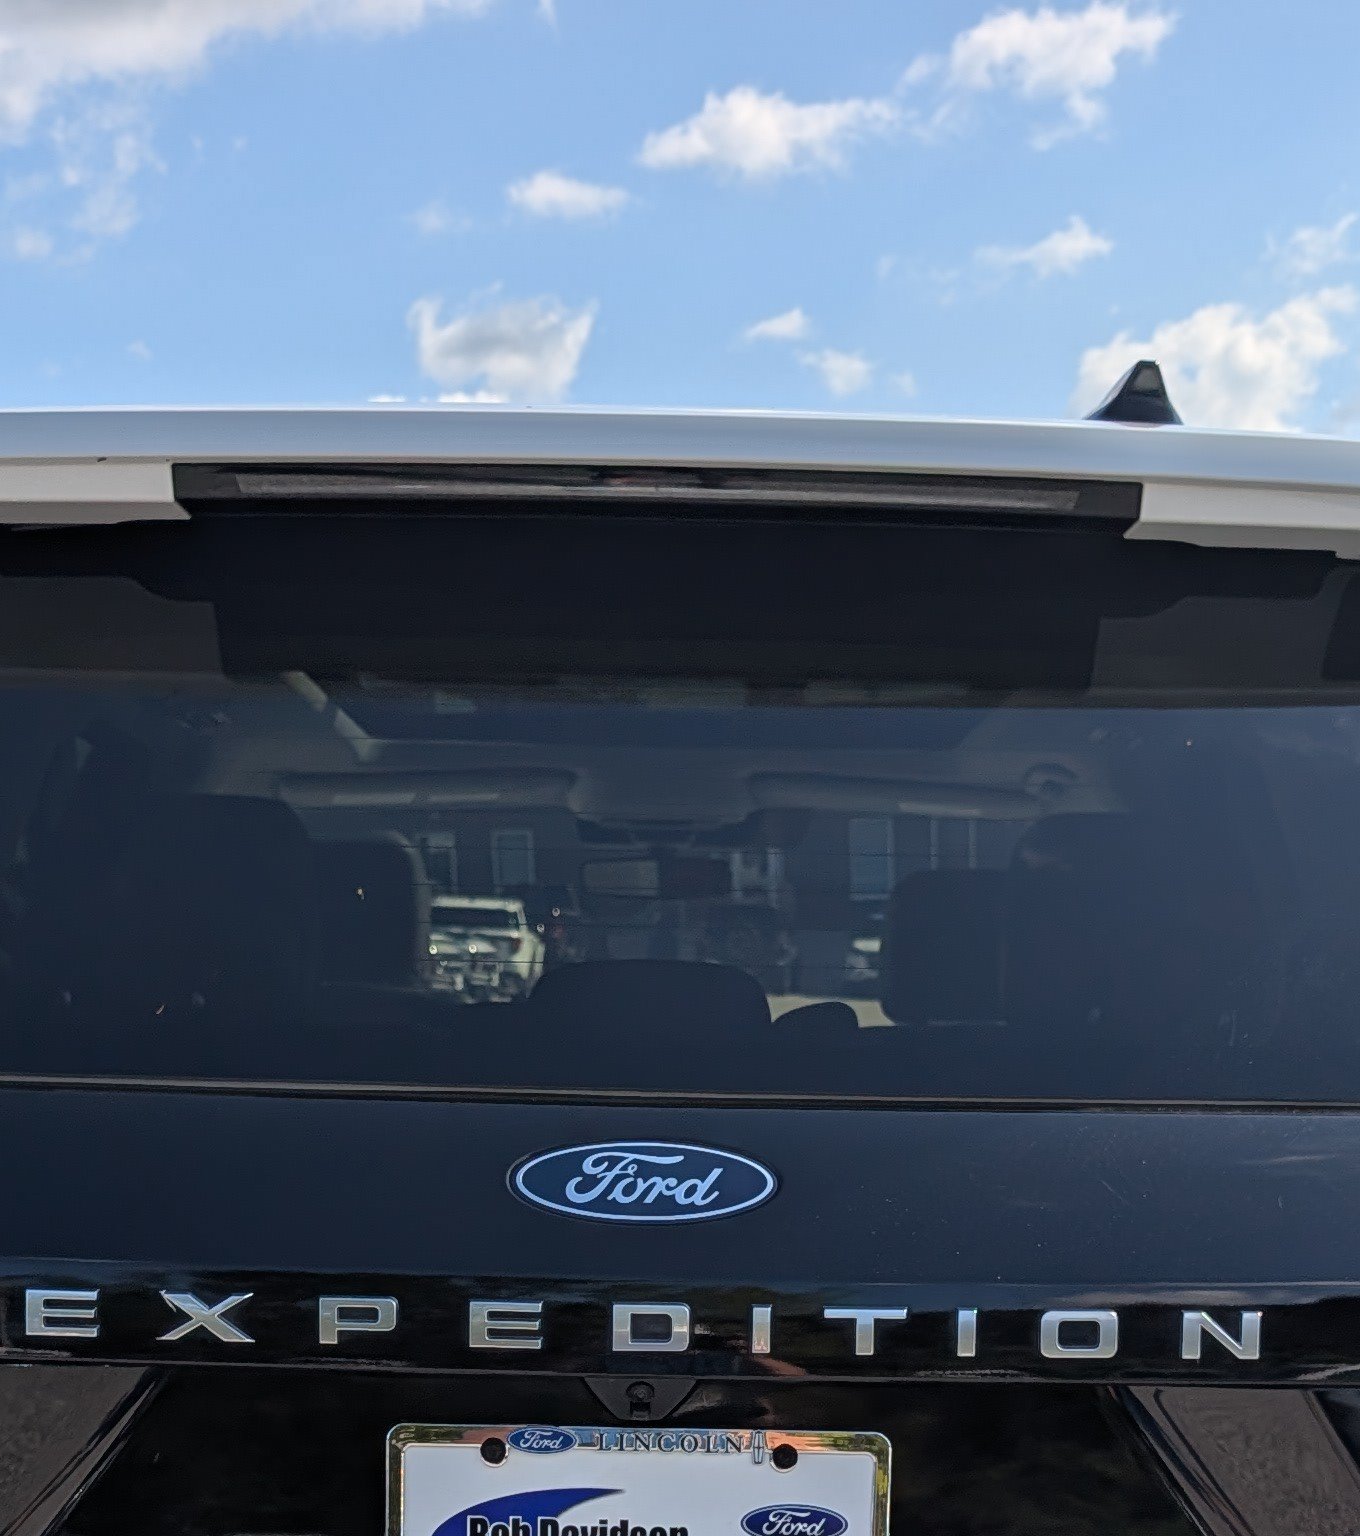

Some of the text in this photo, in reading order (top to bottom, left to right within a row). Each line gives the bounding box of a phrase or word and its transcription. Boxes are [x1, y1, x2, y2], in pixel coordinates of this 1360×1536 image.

[565, 1151, 725, 1206] Ford
[25, 1289, 1263, 1361] EXPEDITION
[597, 1432, 744, 1454] LINCOLN
